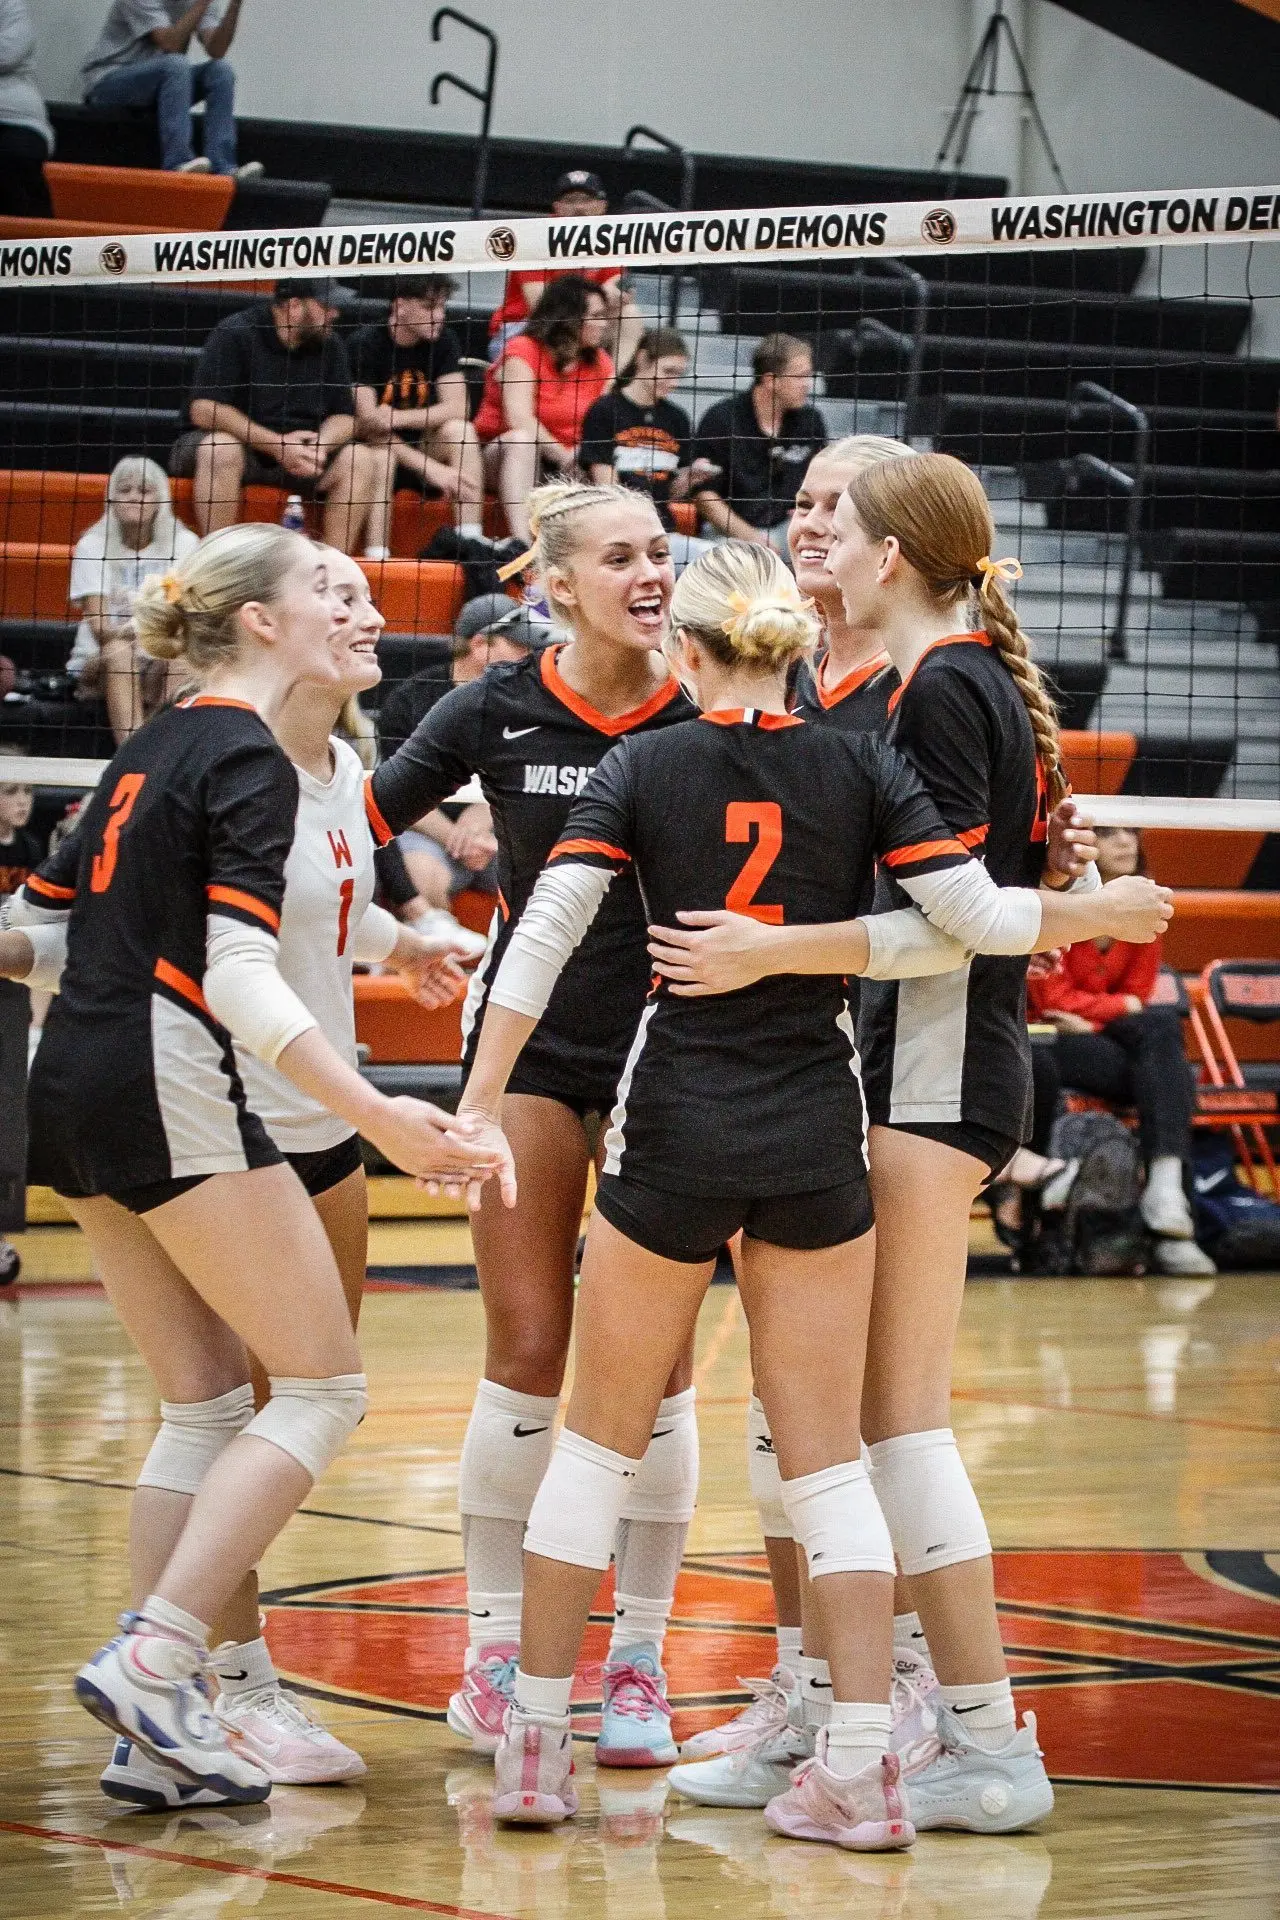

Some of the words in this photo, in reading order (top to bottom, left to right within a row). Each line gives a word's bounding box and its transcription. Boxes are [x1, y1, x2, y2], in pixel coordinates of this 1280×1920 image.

[548, 217, 750, 258] WASHINGTON
[754, 212, 888, 250] DEMONS
[991, 197, 1219, 241] WASHINGTON
[0, 245, 73, 276] MONS
[154, 235, 333, 272] WASHINGTON
[339, 231, 456, 266] DEMONS
[89, 773, 146, 893] 3
[326, 829, 353, 869] W
[725, 801, 785, 925] 2
[336, 878, 354, 957] 1
